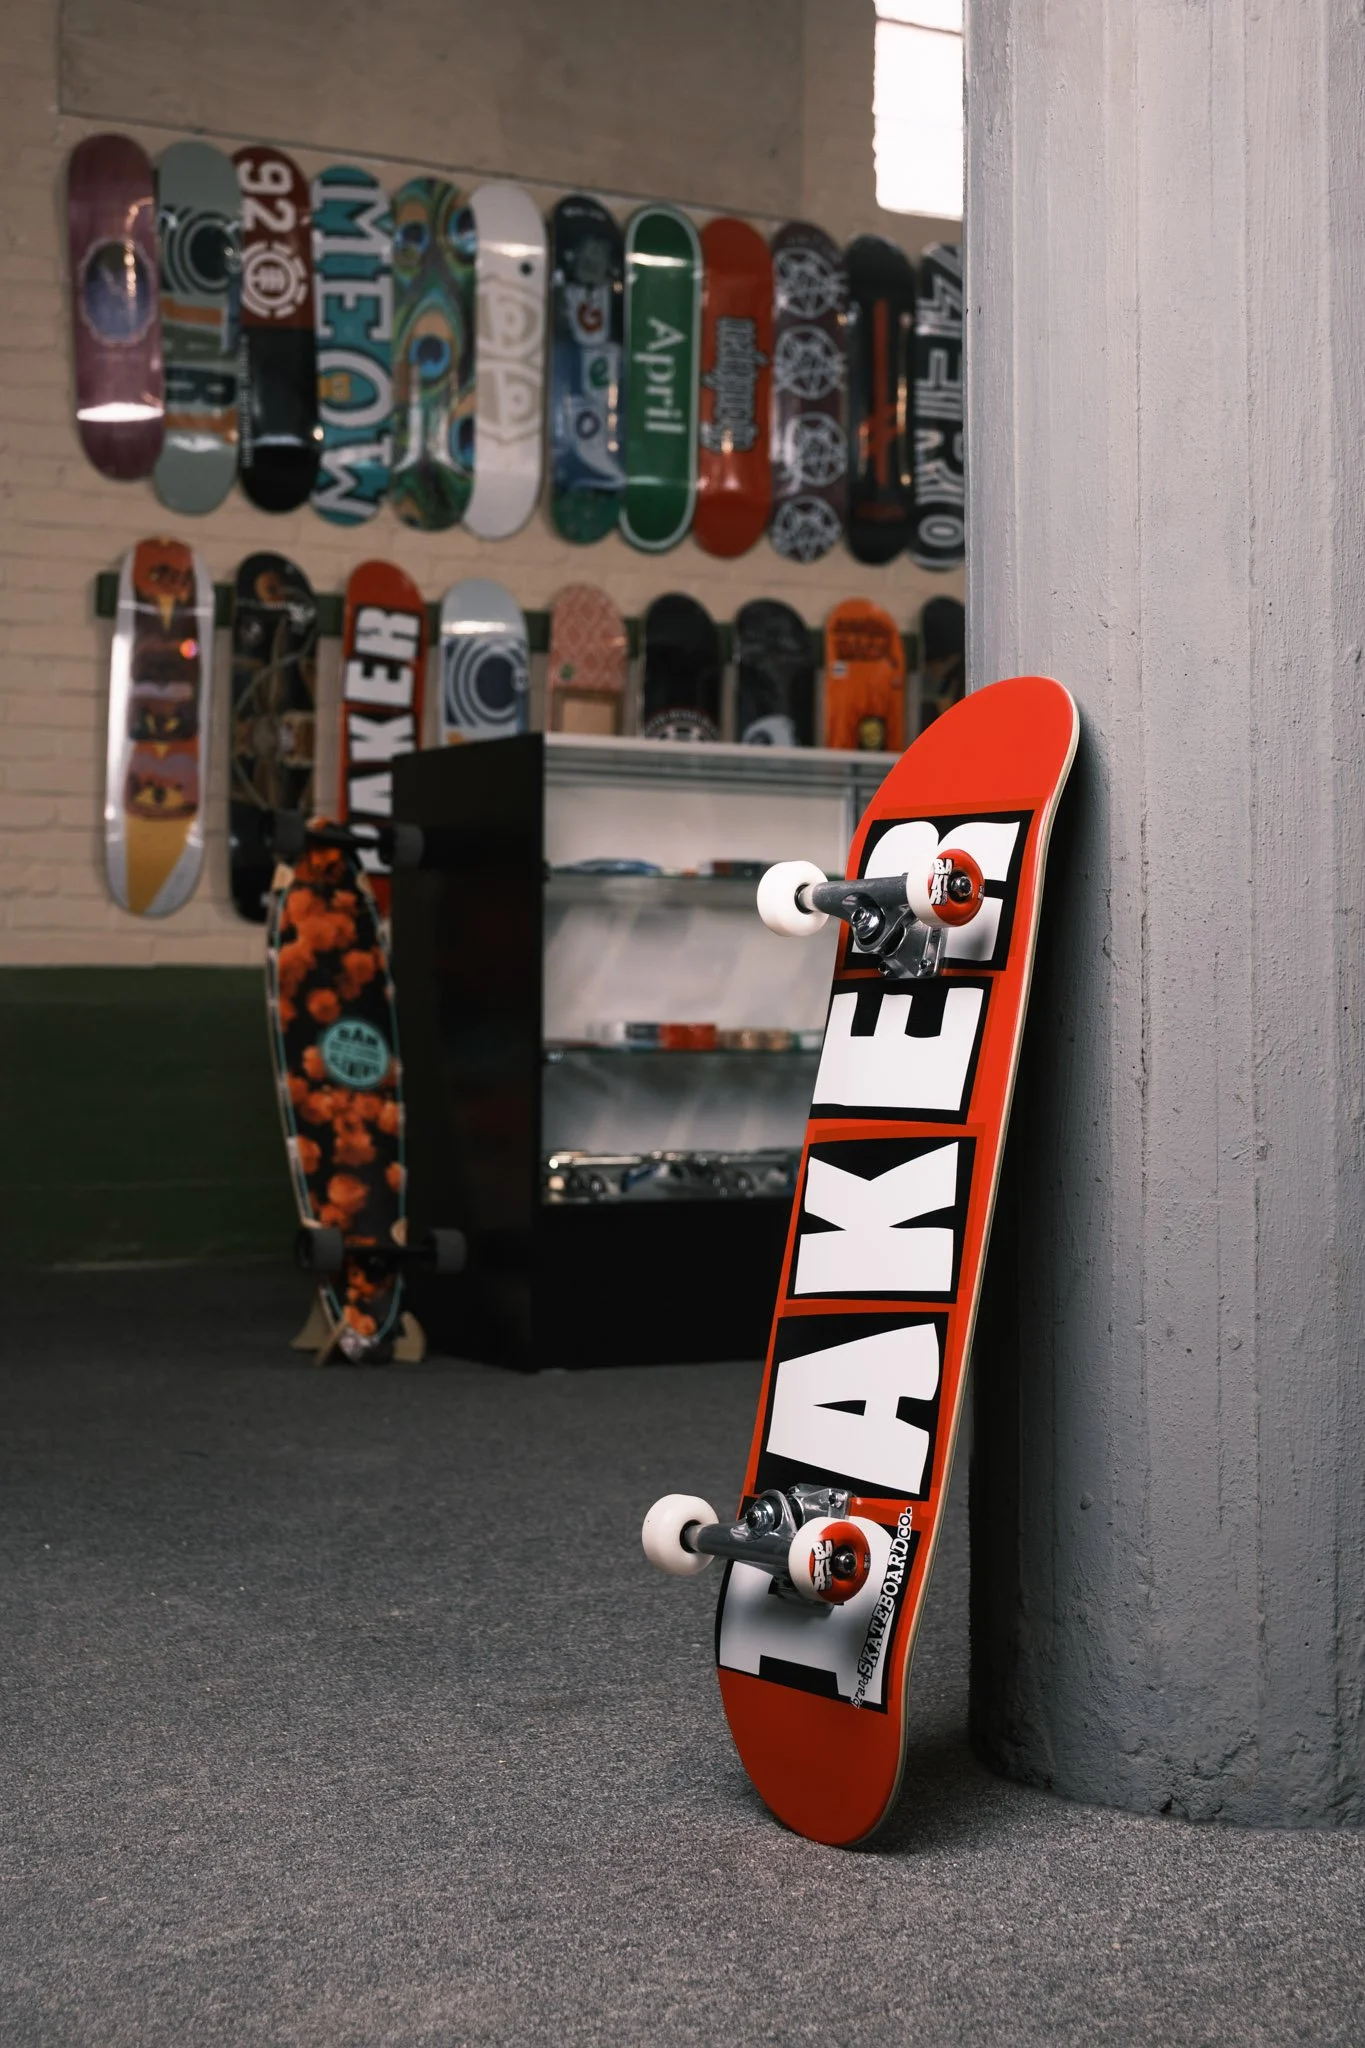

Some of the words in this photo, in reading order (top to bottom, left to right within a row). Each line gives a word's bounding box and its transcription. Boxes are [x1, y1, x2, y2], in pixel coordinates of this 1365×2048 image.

[237, 160, 297, 233] 92
[312, 182, 394, 516] MEOW
[633, 317, 686, 434] April
[857, 1537, 909, 1678] SKATEBOARD
